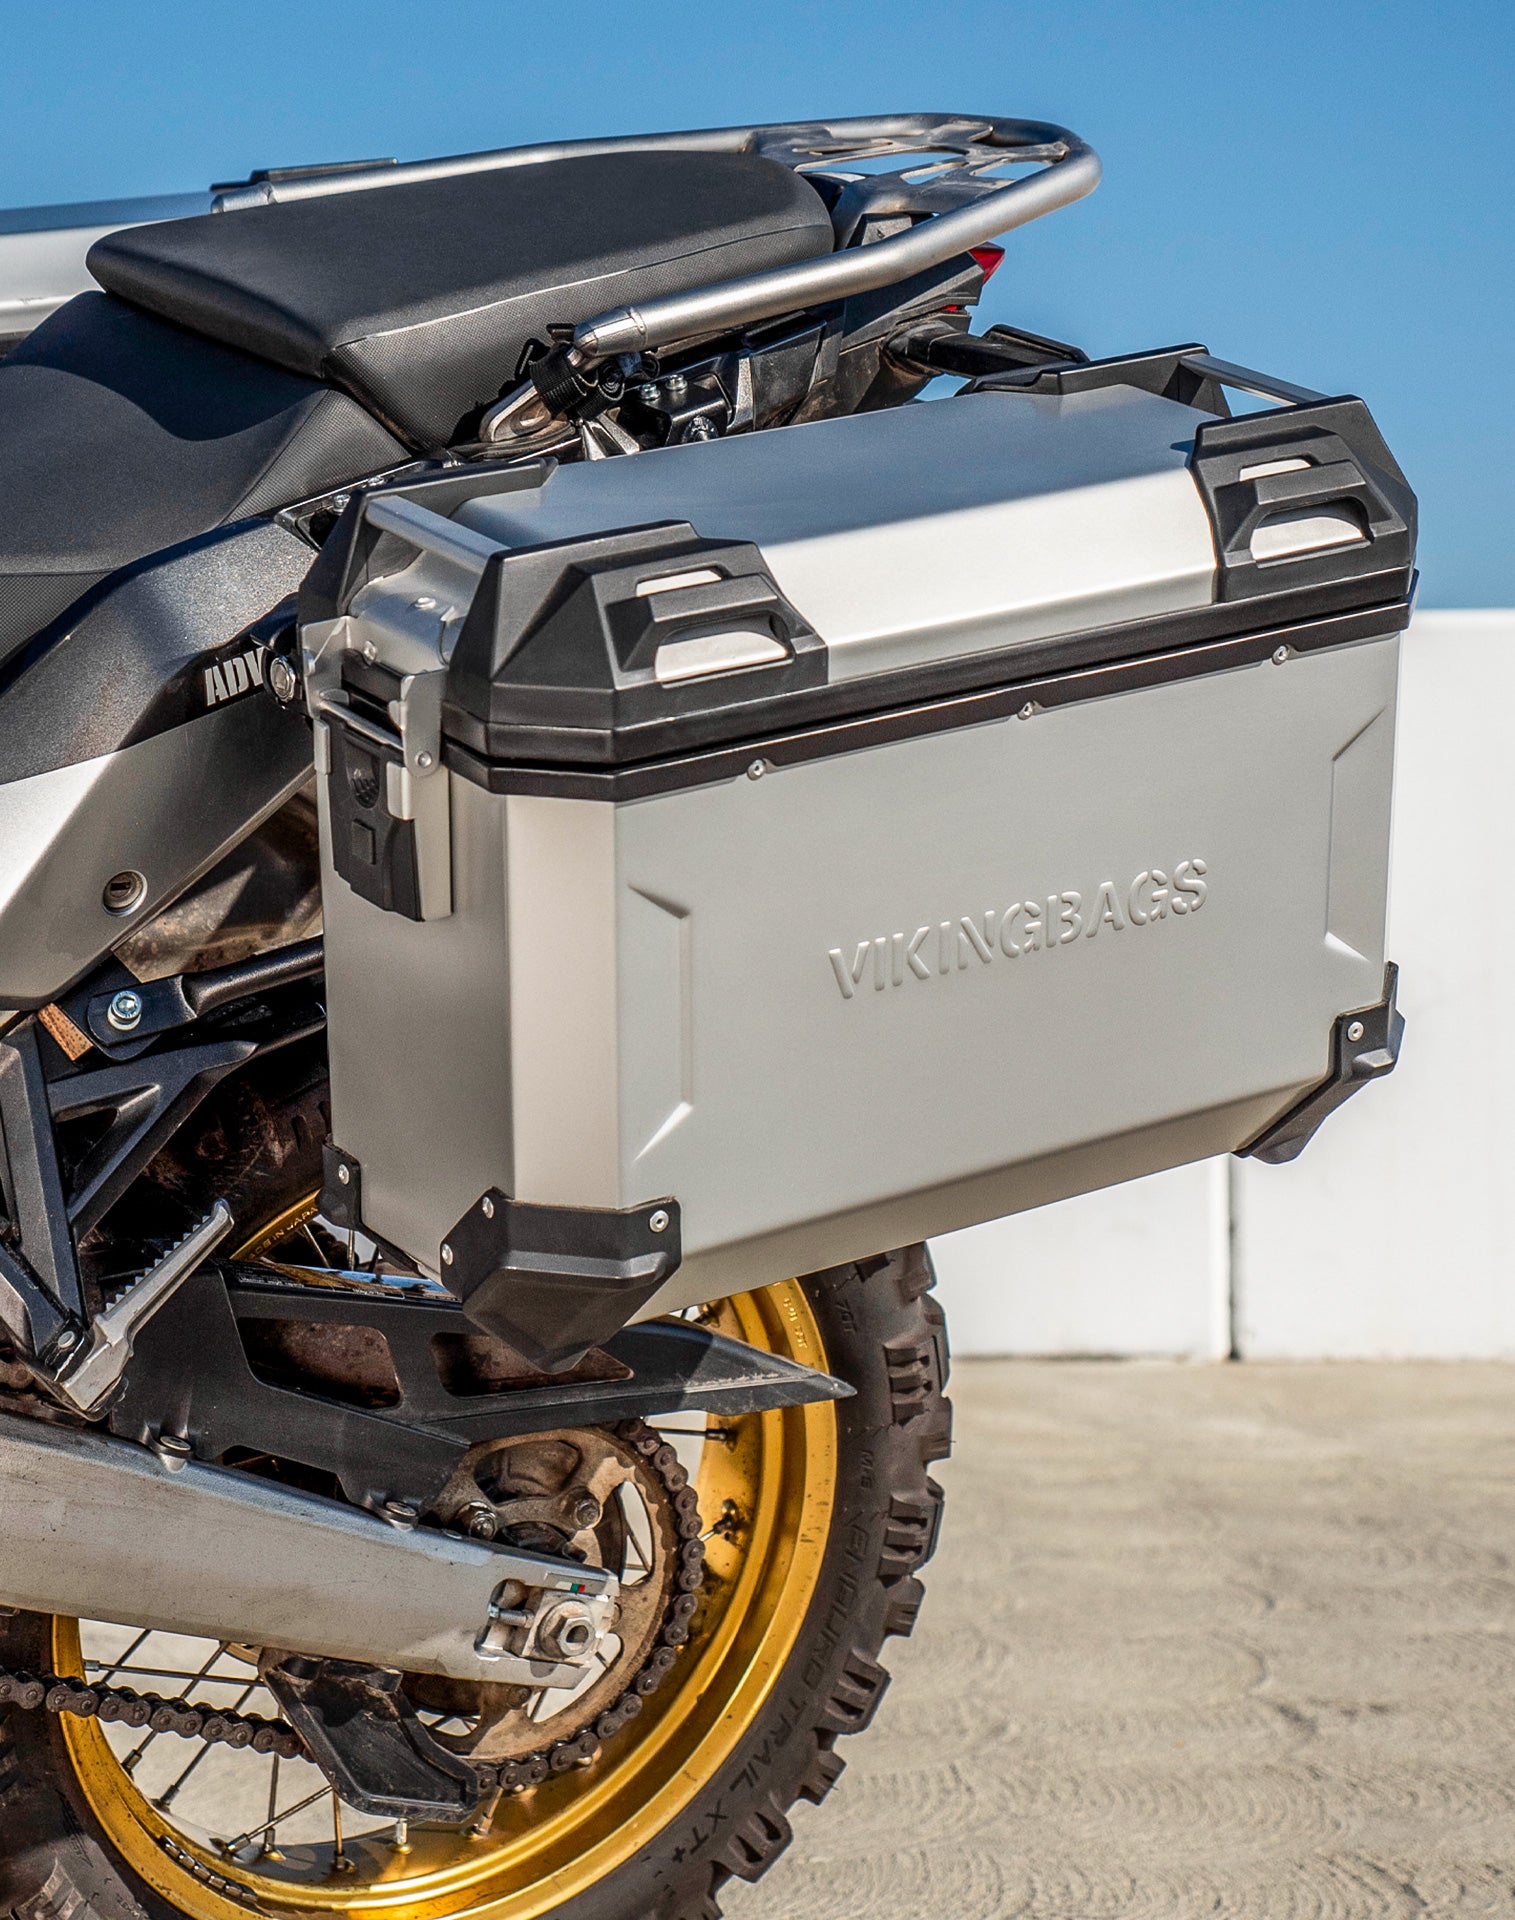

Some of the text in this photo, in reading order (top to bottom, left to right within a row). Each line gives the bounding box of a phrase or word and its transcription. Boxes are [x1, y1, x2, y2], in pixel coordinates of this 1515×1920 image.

[204, 646, 266, 706] ADV
[828, 858, 1208, 1000] VIKINGBAGS
[729, 1697, 808, 1792] TRAIL
